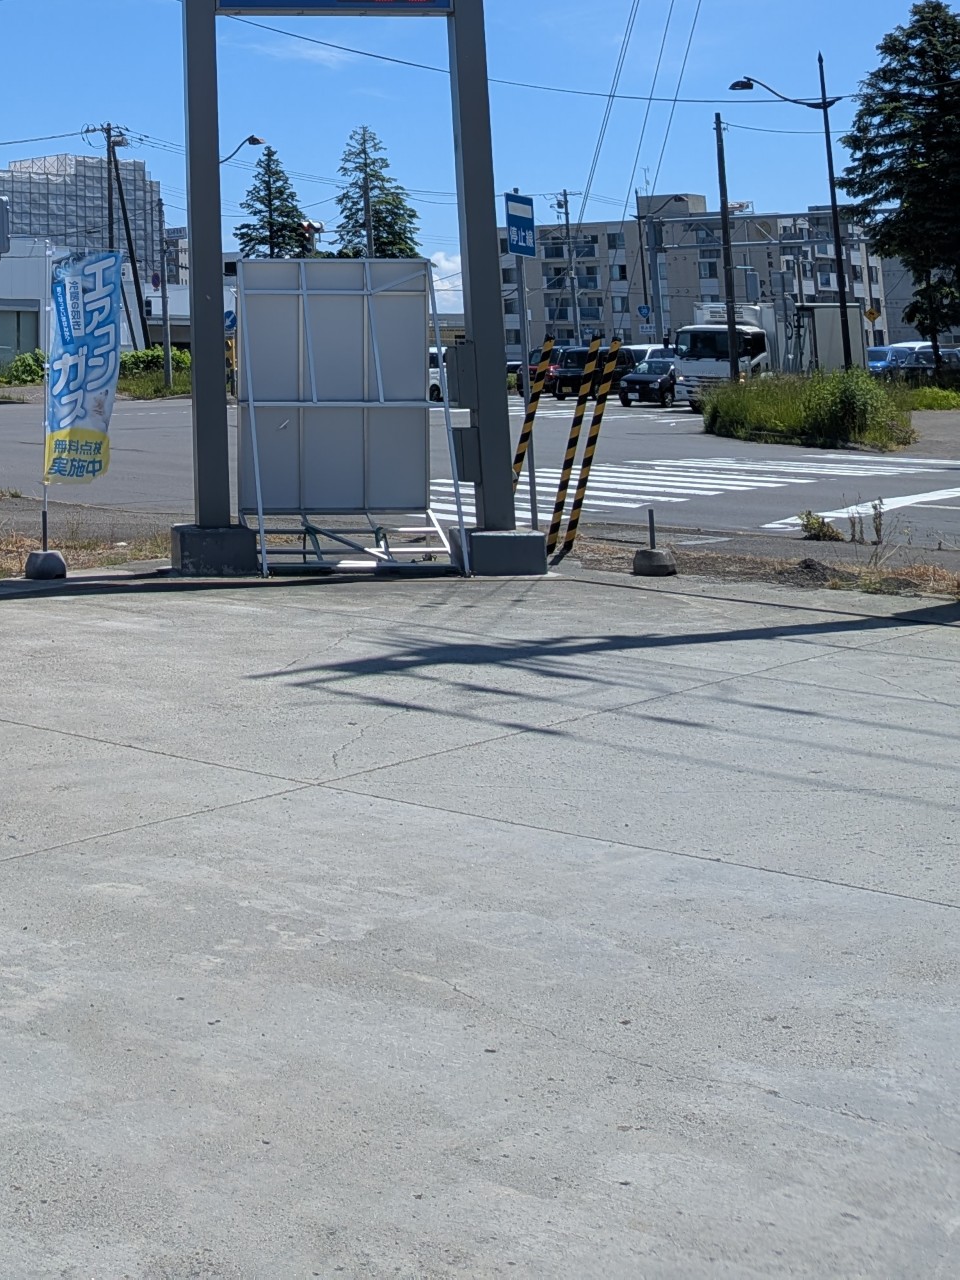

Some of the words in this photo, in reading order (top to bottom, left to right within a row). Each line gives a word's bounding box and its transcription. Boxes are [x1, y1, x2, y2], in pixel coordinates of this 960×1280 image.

[509, 226, 534, 247] 停止線
[83, 256, 116, 391] エアコン
[52, 346, 88, 428] ガス
[48, 457, 102, 477] 実施中
